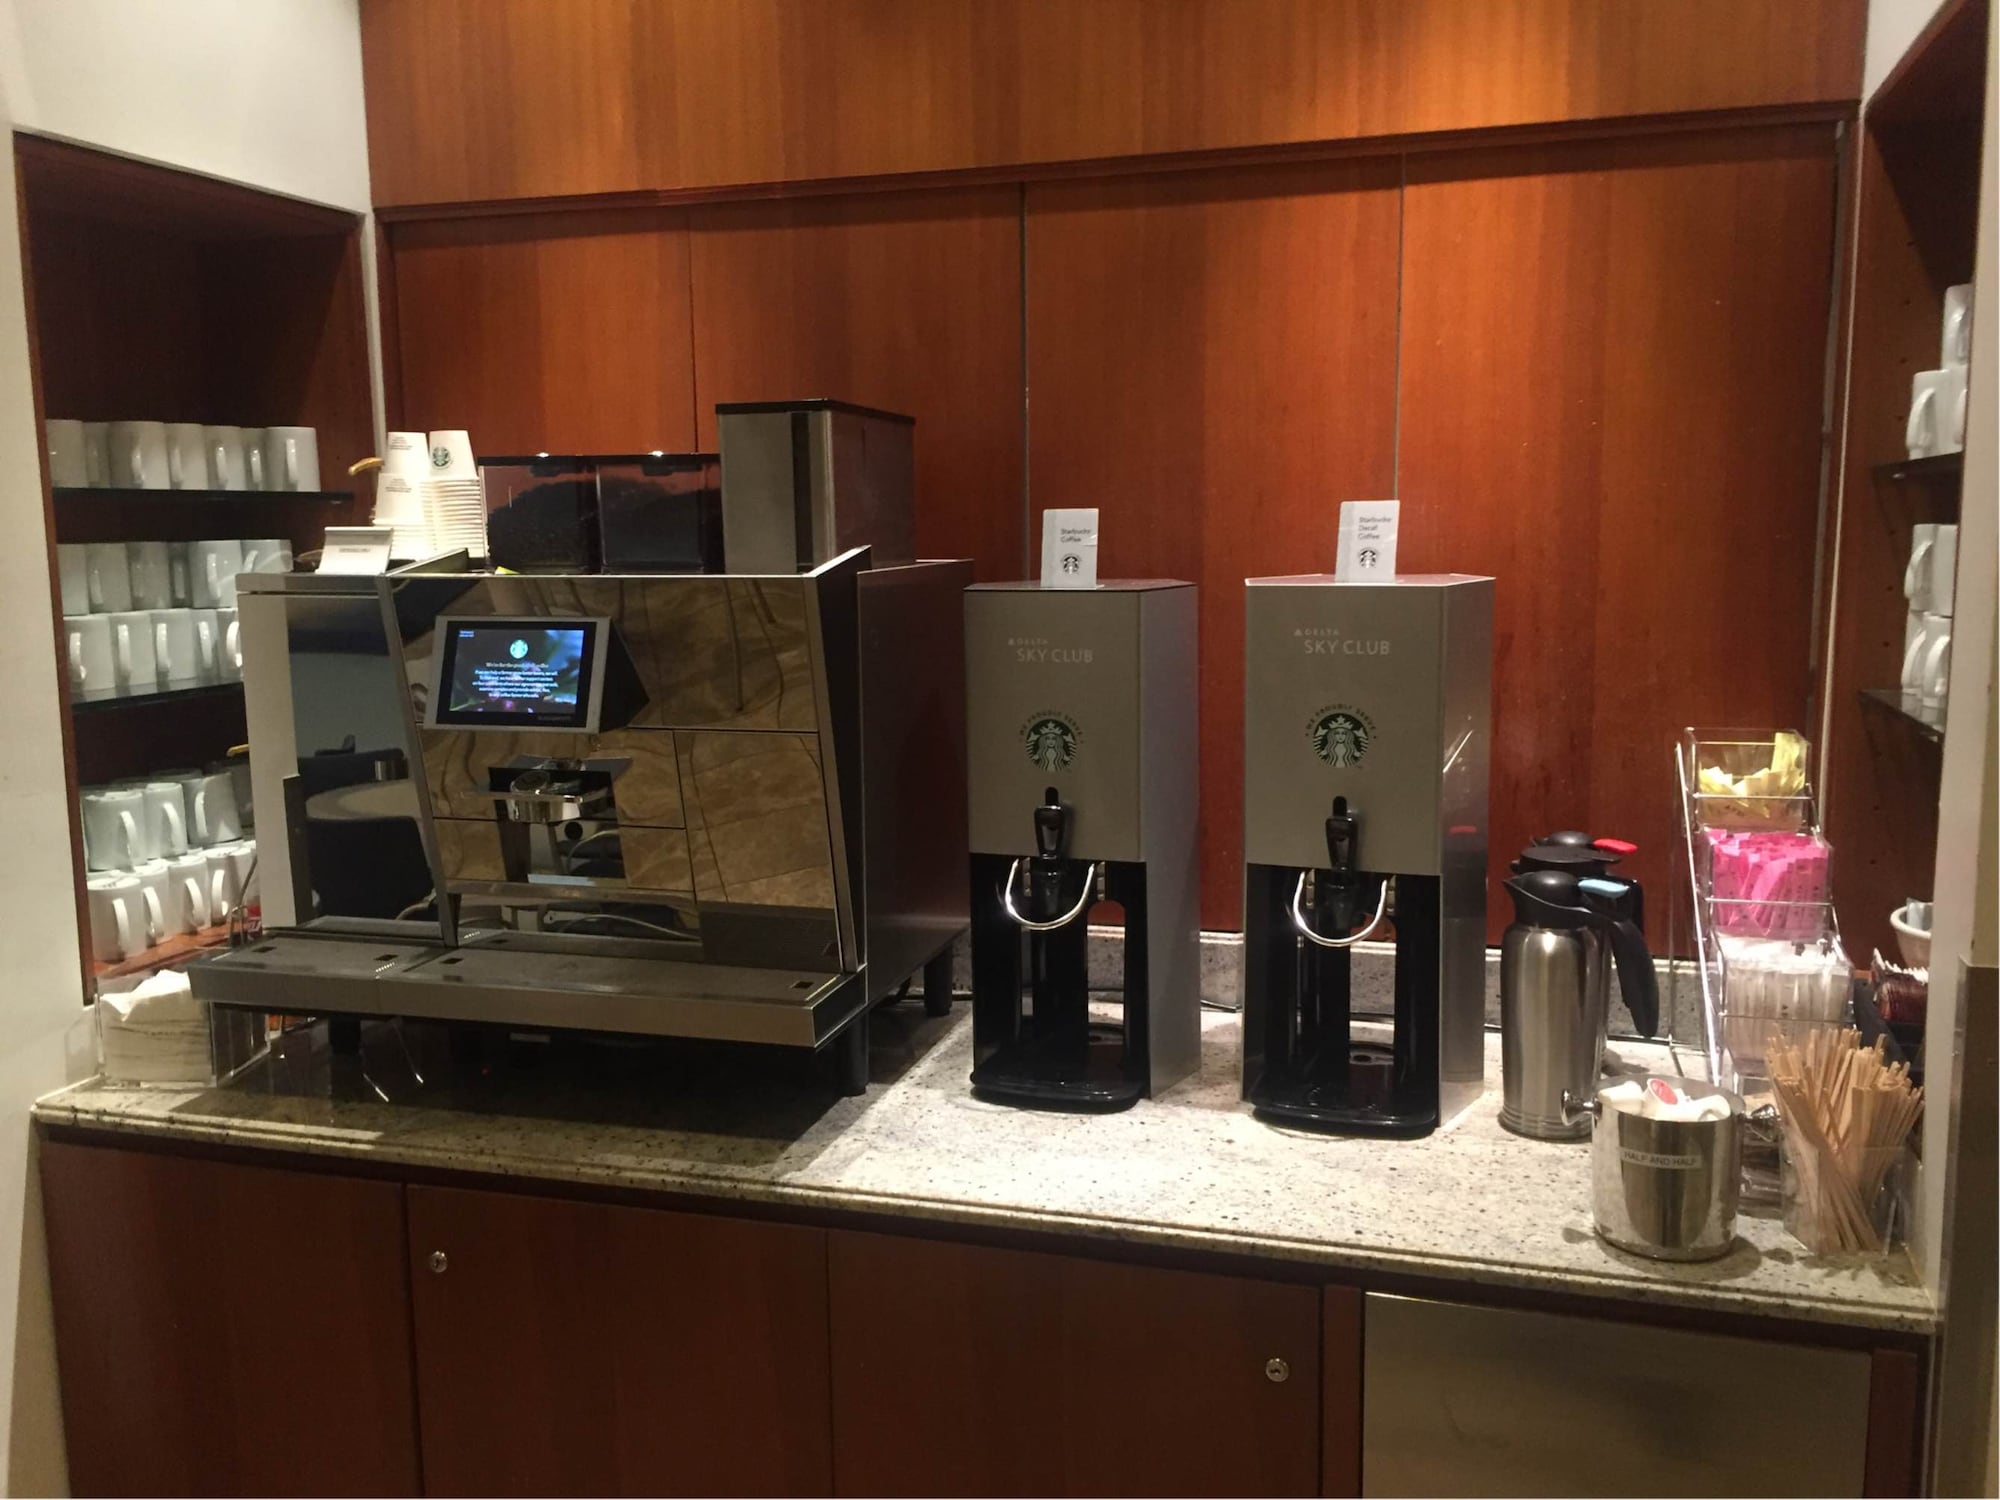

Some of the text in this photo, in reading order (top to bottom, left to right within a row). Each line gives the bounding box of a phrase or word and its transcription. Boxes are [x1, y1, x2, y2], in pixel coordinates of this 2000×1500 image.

[1304, 627, 1340, 637] DELTA
[1016, 647, 1094, 664] SKY CLUB
[1304, 639, 1391, 656] SKY CLUB
[1624, 1151, 1697, 1167] HALF AND HALF
